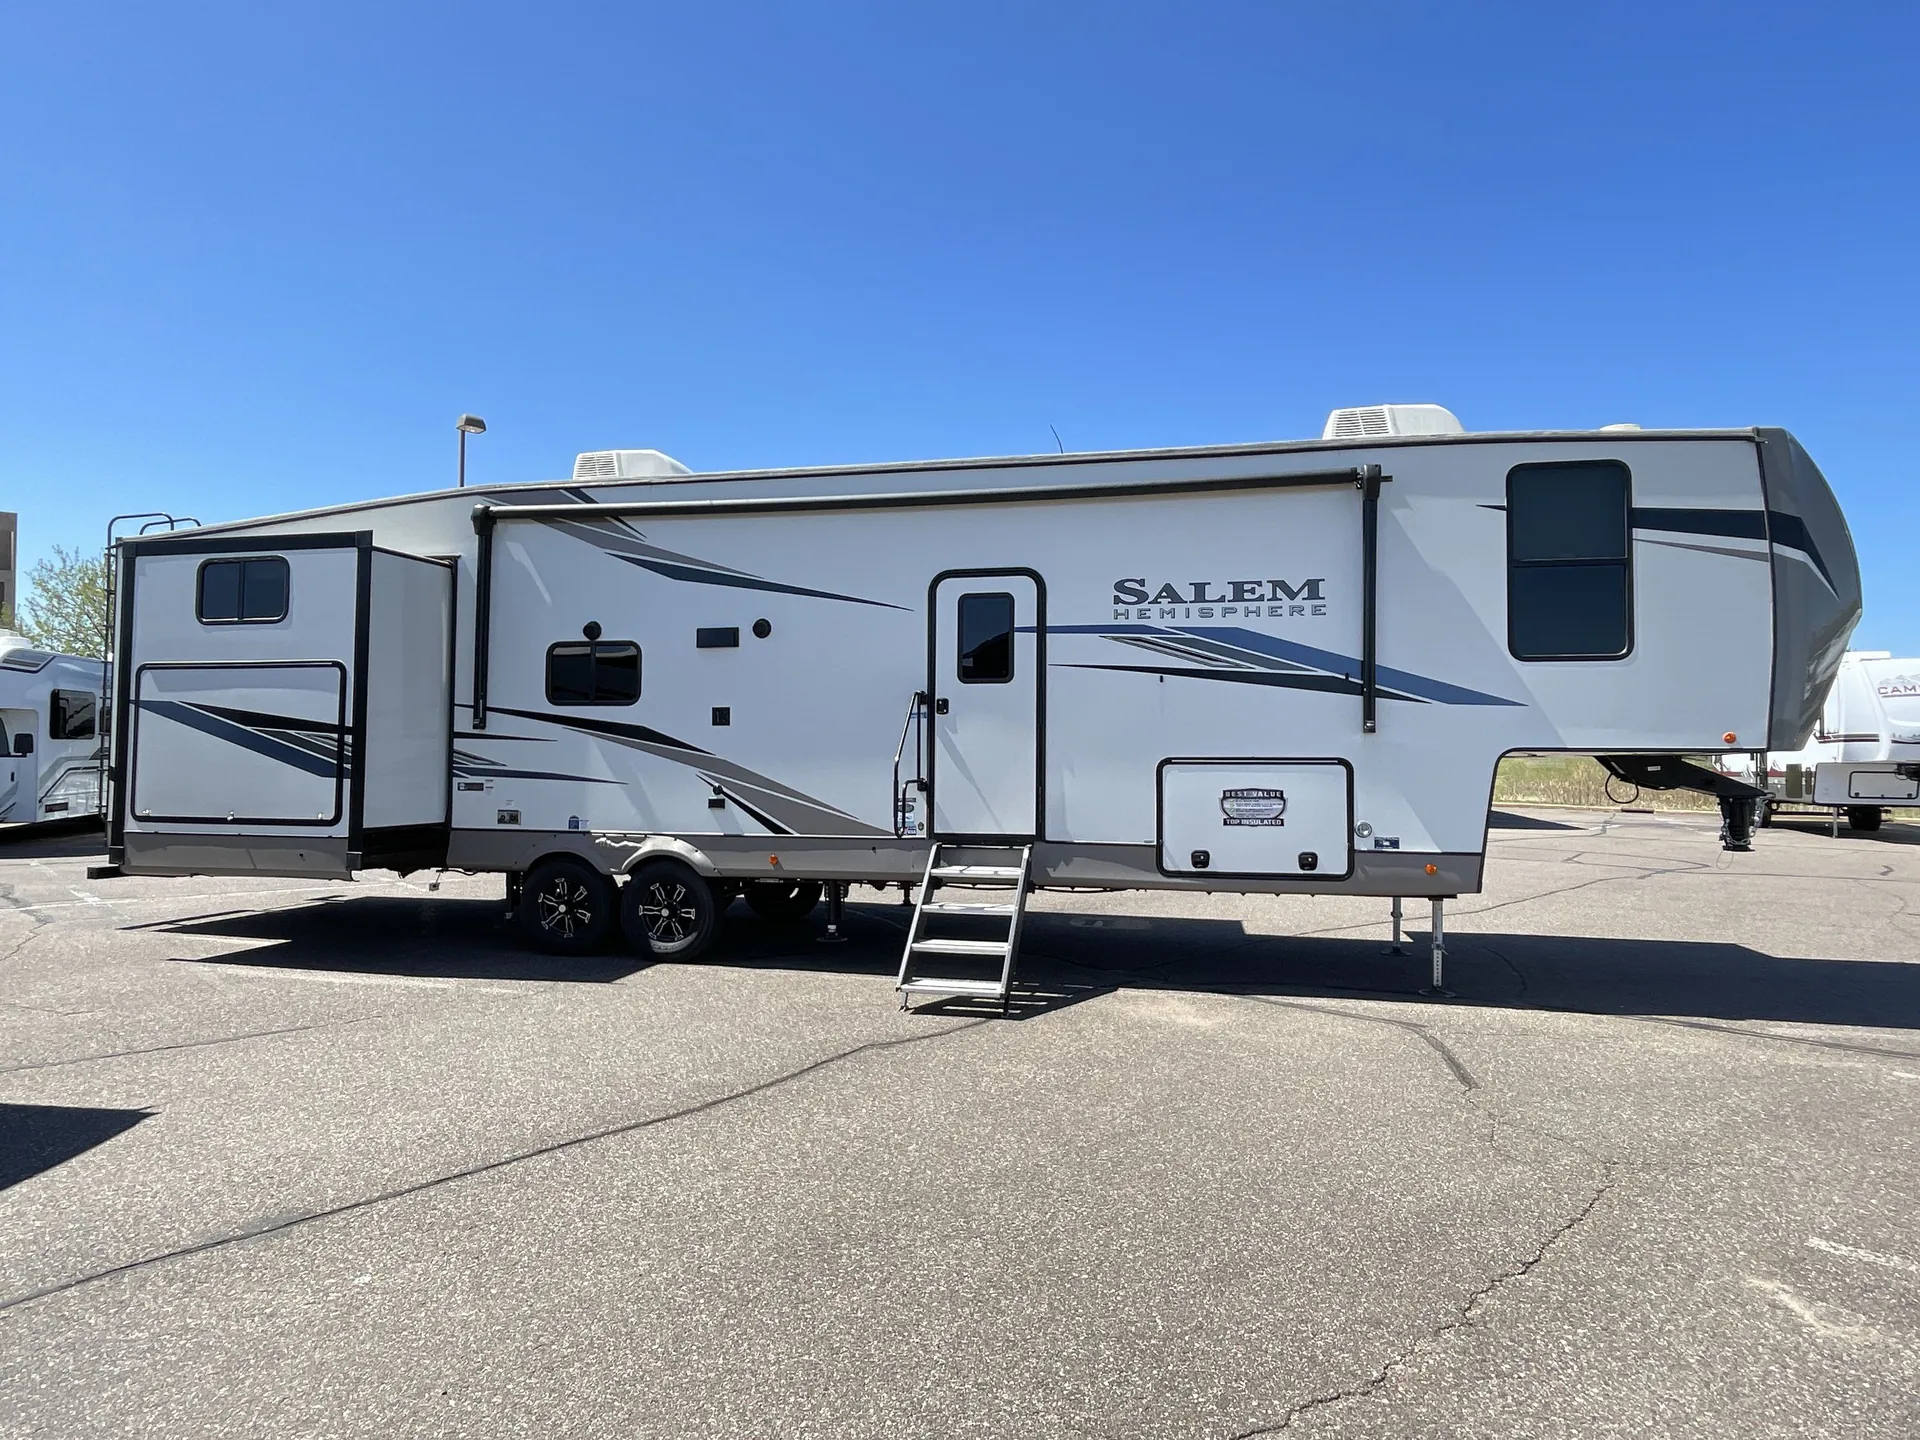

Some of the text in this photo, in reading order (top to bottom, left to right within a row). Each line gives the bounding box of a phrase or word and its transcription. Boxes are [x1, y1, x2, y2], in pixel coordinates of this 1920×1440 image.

[1113, 578, 1325, 605] SALEM
[1113, 604, 1327, 620] HEMISPHERE
[1877, 685, 1920, 695] CAM
